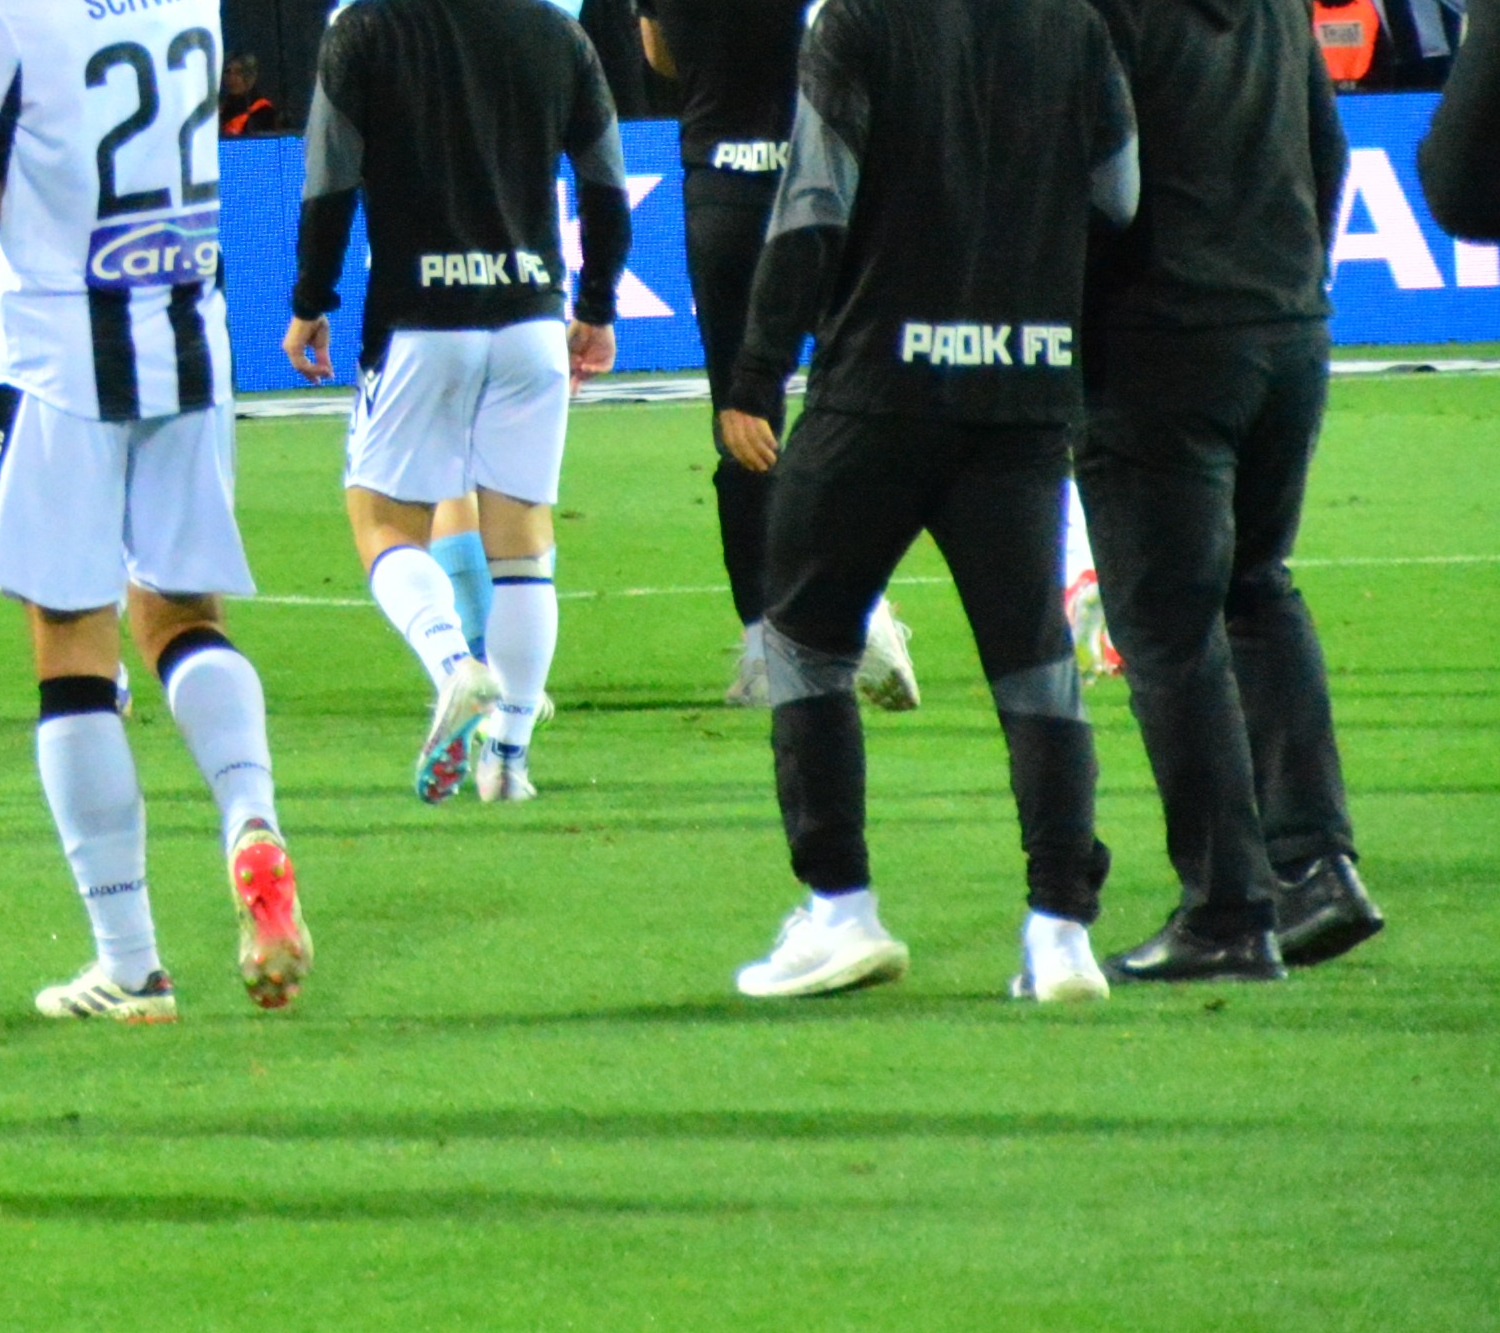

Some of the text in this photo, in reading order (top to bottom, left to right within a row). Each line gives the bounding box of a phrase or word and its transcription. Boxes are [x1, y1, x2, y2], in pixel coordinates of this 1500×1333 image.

[84, 27, 219, 221] 22
[713, 140, 790, 173] PAOK
[420, 252, 512, 288] PAOK
[901, 322, 1073, 367] PAOK FC
